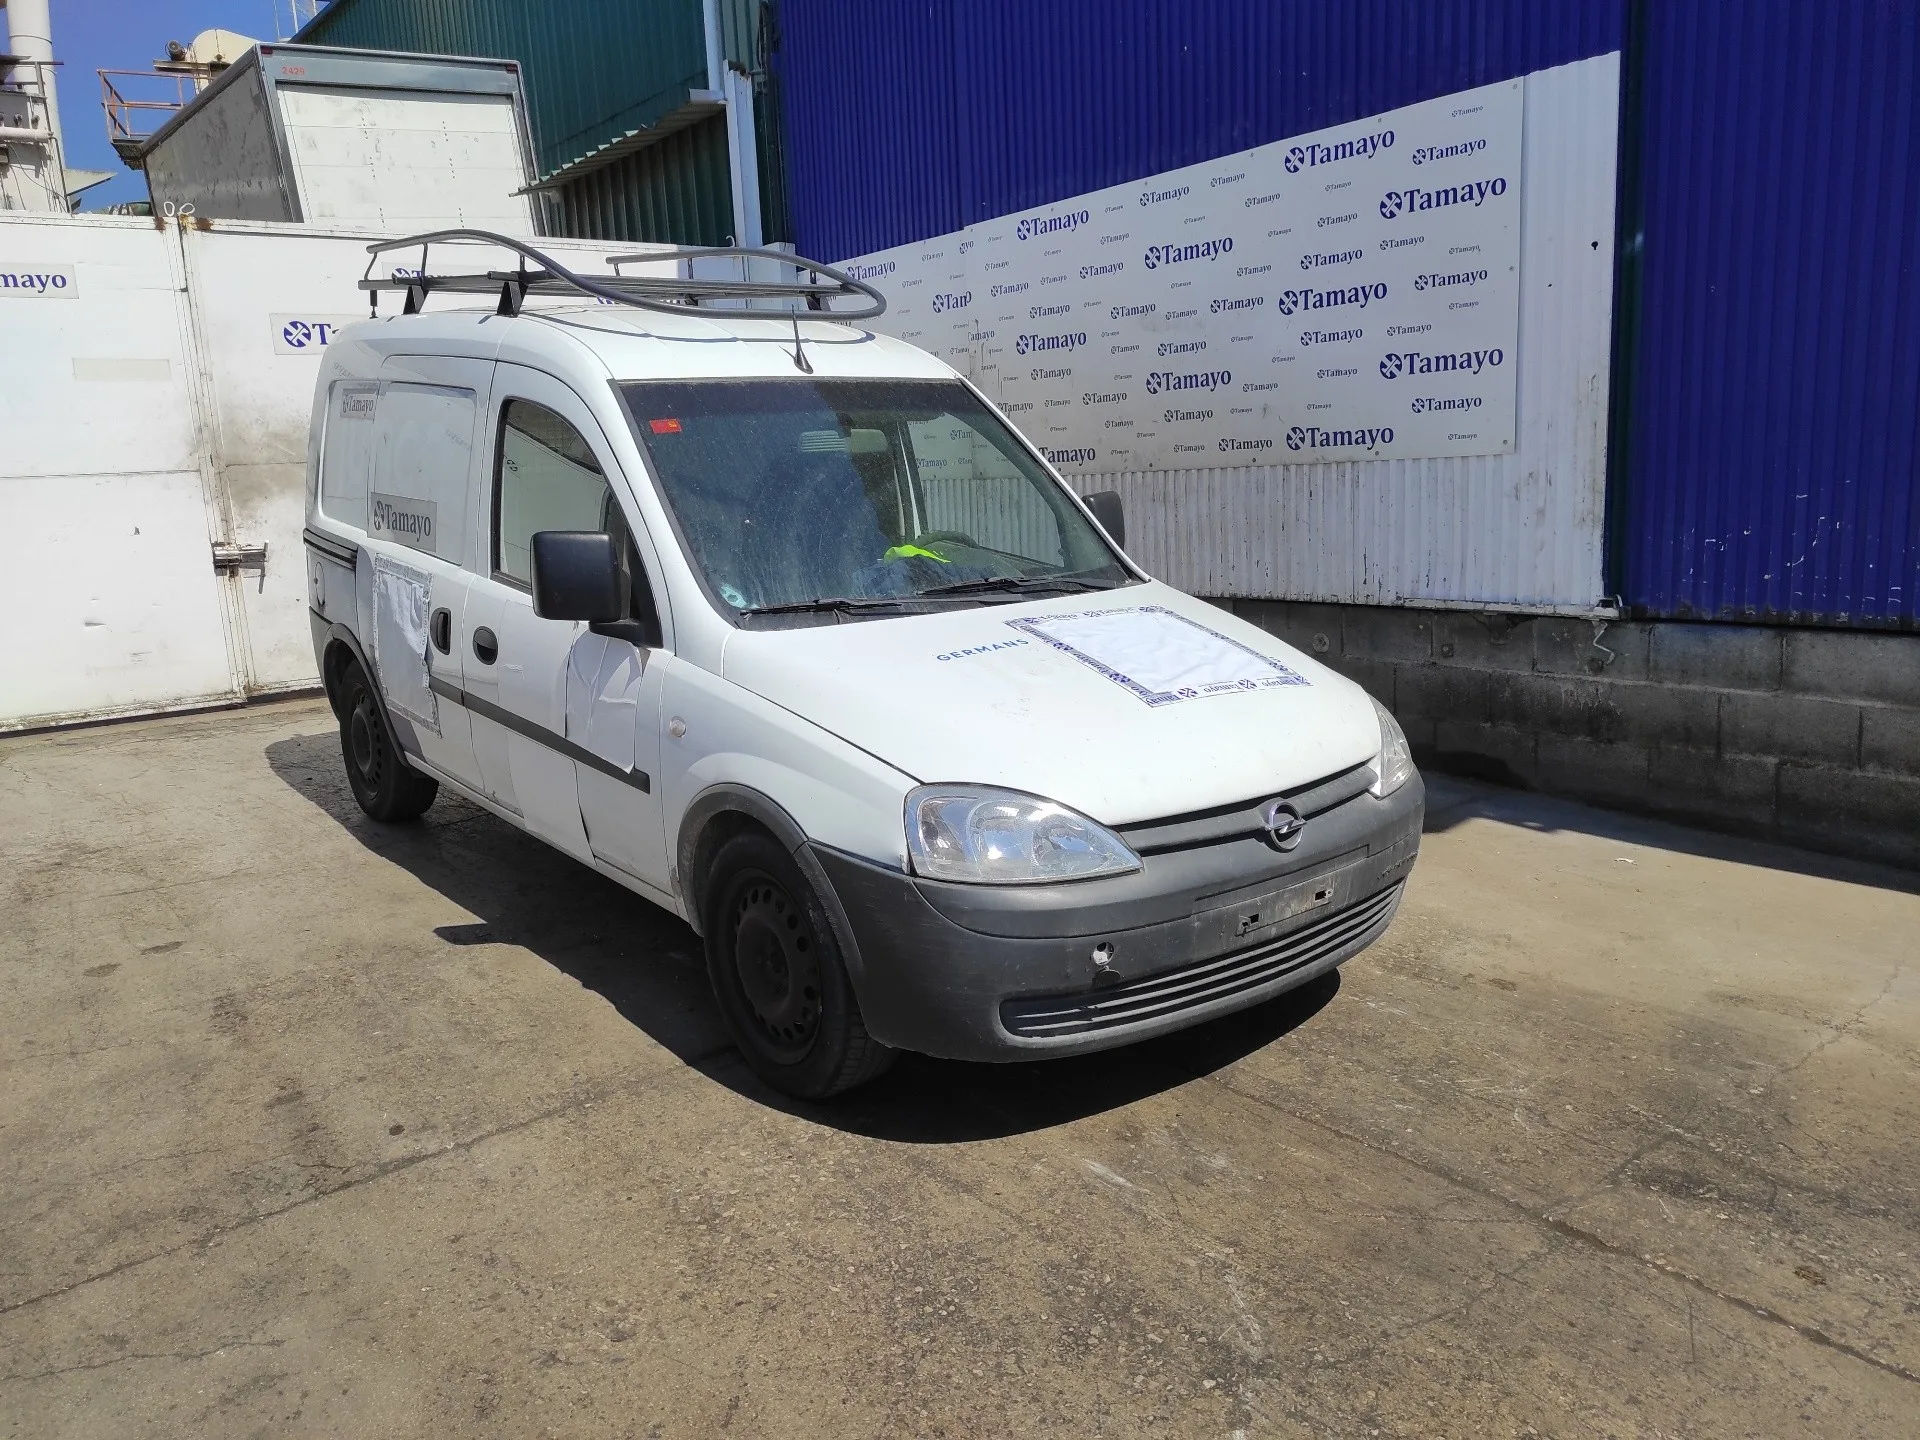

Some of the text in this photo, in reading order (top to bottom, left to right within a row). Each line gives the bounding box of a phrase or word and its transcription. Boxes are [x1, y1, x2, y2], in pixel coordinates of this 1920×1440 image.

[280, 66, 305, 76] 2429
[1458, 105, 1484, 118] Tamayo
[1306, 130, 1395, 167] Tamayo
[1427, 137, 1487, 162] Tamayo
[1218, 172, 1246, 186] Tamayo
[1150, 185, 1190, 204] Tamayo
[1252, 192, 1281, 206] Tamayo
[1404, 176, 1507, 214] Tamayo
[1031, 210, 1089, 236] Tamayo
[1325, 212, 1358, 226] Tamayo
[1106, 232, 1130, 244] Tamayo
[1273, 228, 1292, 237] Tamayo
[1162, 236, 1234, 264] Tamayo
[1388, 236, 1425, 250] Tamayo
[1455, 244, 1480, 254] Tamayo
[990, 260, 1010, 270] Tamayo
[1312, 248, 1363, 268] Tamayo
[855, 260, 896, 281] Tamayo
[1088, 262, 1124, 276] Tamayo
[1245, 264, 1272, 276] Tamayo
[1046, 274, 1067, 284] Tamayo
[1428, 268, 1488, 288] Tamayo
[998, 281, 1029, 295] Tamayo
[1222, 296, 1264, 312] Tamayo
[1300, 282, 1388, 312] Tamayo
[1037, 304, 1070, 316] Tamayo
[1120, 302, 1156, 318] Tamayo
[1454, 300, 1480, 310] Tamayo
[1172, 308, 1198, 319] Tamayo
[1313, 328, 1363, 344] Tamayo
[1396, 323, 1432, 336] Tamayo
[1030, 332, 1087, 352] Tamayo
[1117, 344, 1140, 354] Tamayo
[1167, 340, 1207, 355] Tamayo
[1276, 355, 1296, 363] Tamayo
[1404, 348, 1504, 376] Tamayo
[1039, 367, 1072, 380] Tamayo
[1326, 367, 1358, 378] Tamayo
[1162, 370, 1232, 392] Tamayo
[1250, 382, 1278, 392] Tamayo
[1050, 399, 1070, 408] Tamayo
[1092, 391, 1128, 404] Tamayo
[1426, 396, 1482, 412] Tamayo
[348, 393, 374, 417] Tamayo
[1004, 401, 1034, 413] Tamayo
[1174, 408, 1214, 422] Tamayo
[1111, 420, 1134, 428] Tamayo
[1306, 426, 1394, 450] Tamayo
[1454, 432, 1478, 440] Tamayo
[1179, 444, 1205, 454] Tamayo
[1229, 438, 1272, 452] Tamayo
[921, 458, 948, 468] Tamayo
[1038, 446, 1096, 466] Tamayo
[385, 504, 432, 542] Tamayo
[936, 638, 1029, 662] GERMANS
